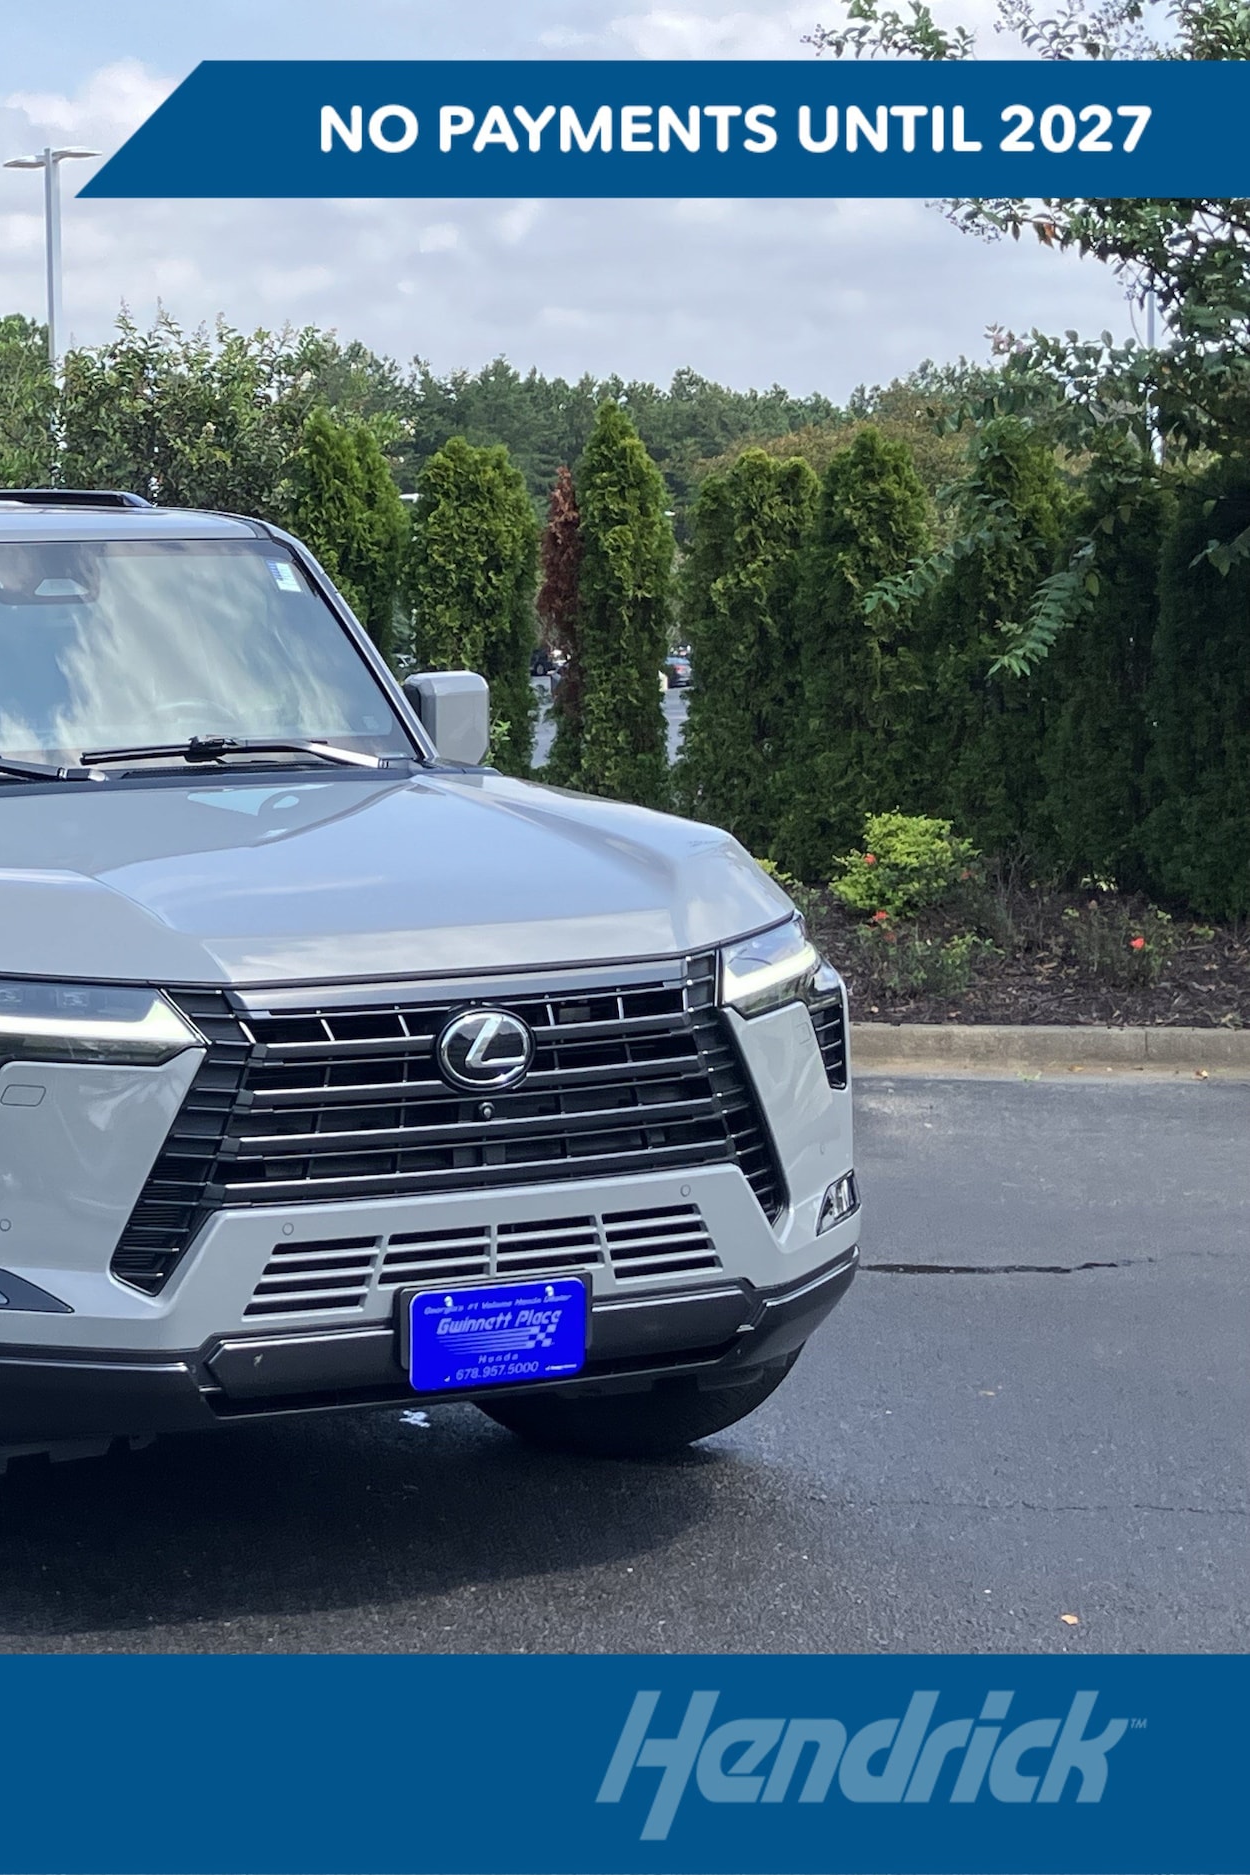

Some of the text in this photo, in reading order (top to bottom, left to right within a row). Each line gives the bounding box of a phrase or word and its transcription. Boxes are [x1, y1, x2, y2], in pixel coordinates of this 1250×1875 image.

[436, 1308, 562, 1335] Gwinnett Place
[477, 1352, 519, 1364] Honda
[455, 1360, 539, 1382] 678.957.5000
